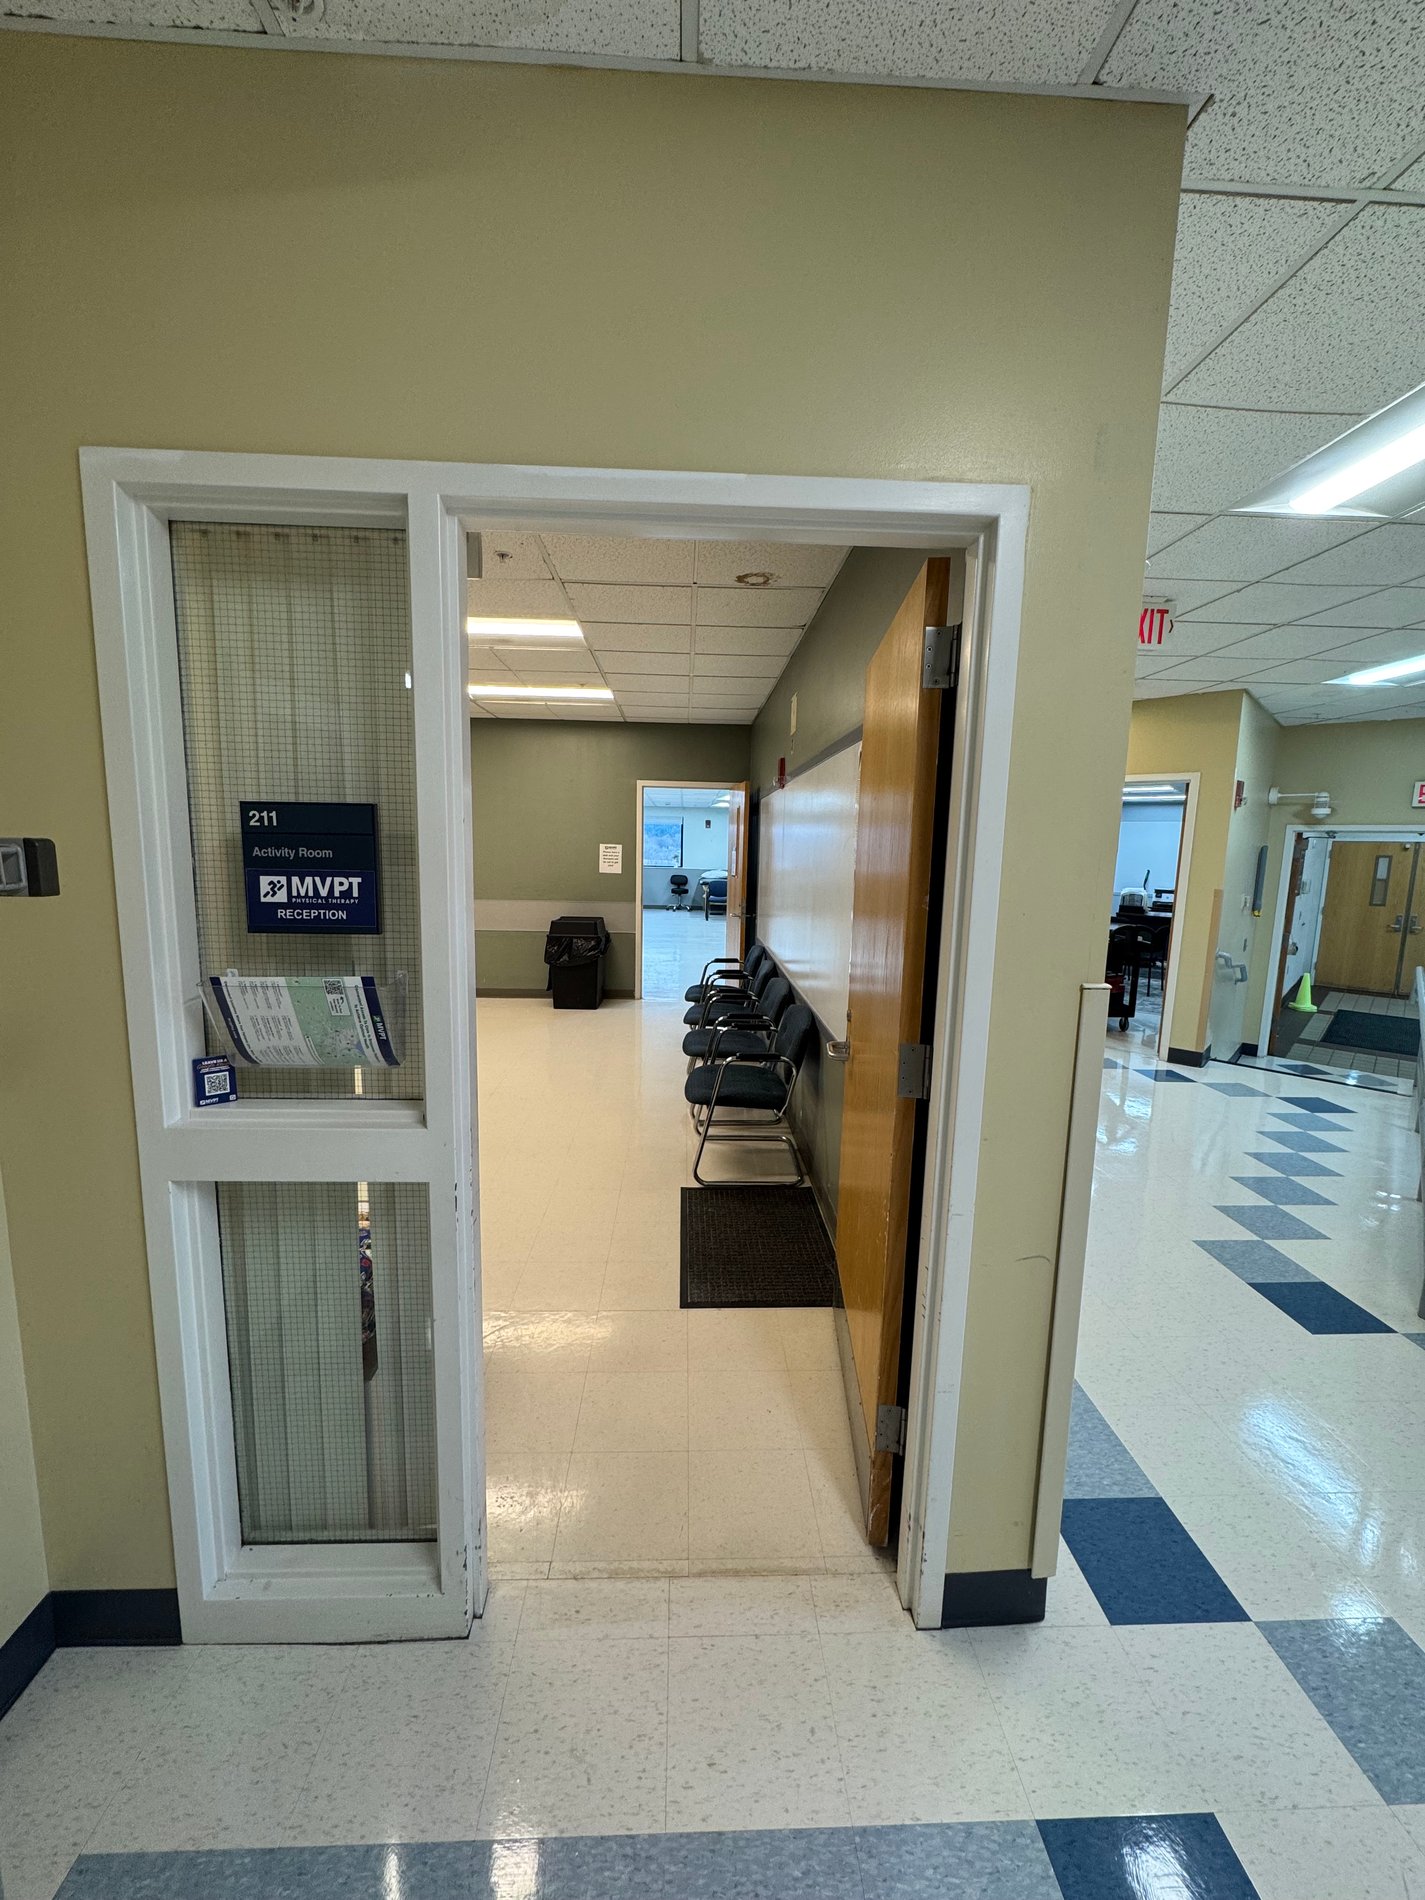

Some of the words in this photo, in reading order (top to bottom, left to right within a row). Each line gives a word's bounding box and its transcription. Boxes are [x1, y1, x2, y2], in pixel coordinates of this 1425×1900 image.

[1138, 608, 1169, 644] XIT
[249, 811, 277, 826] 211
[252, 846, 295, 860] Activity
[298, 847, 333, 858] Room
[291, 876, 362, 897] MVPT
[277, 909, 347, 920] RECEPTION
[376, 1022, 387, 1040] MVPT
